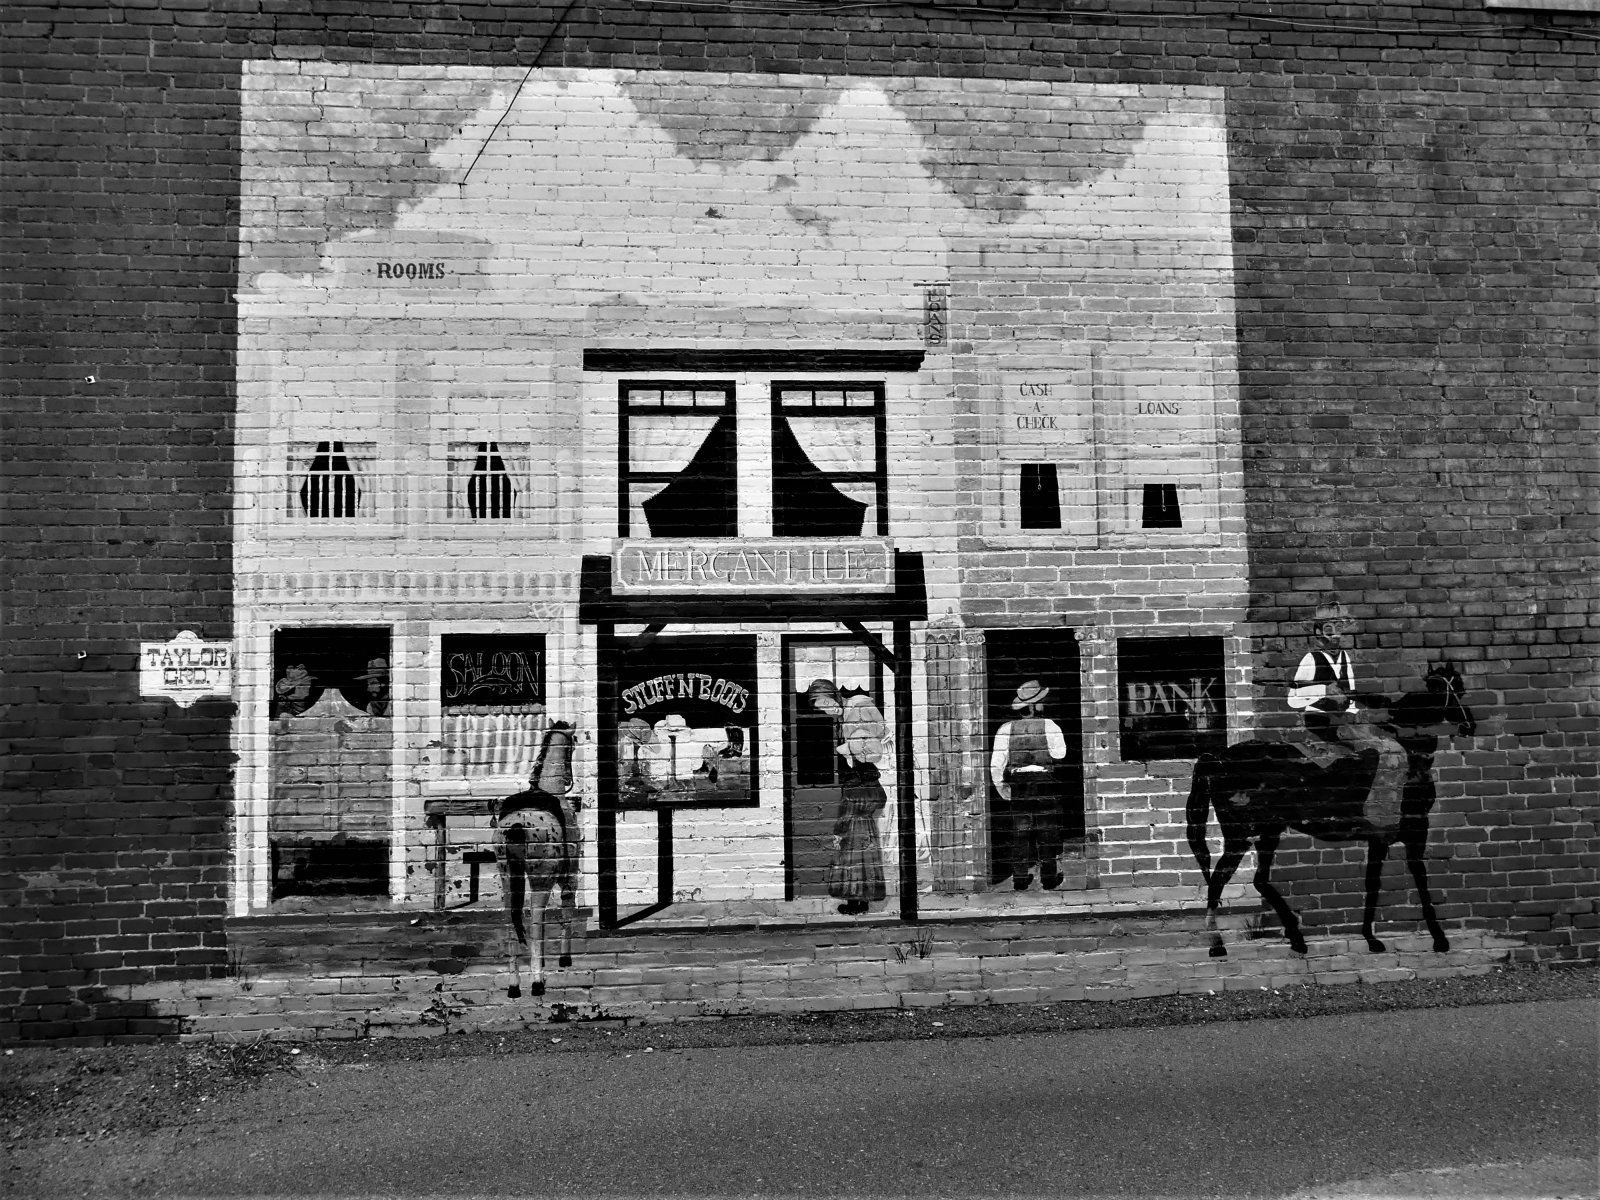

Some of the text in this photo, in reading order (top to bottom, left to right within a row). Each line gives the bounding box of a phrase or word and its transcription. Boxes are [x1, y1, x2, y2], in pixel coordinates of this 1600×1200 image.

[376, 262, 446, 280] ROOMS
[1019, 382, 1053, 396] CASH
[1016, 416, 1058, 430] CHECK
[637, 549, 868, 582] MERCANTILE
[147, 647, 227, 667] TAYLOR
[445, 651, 541, 698] SALOON
[1125, 677, 1218, 715] BANK
